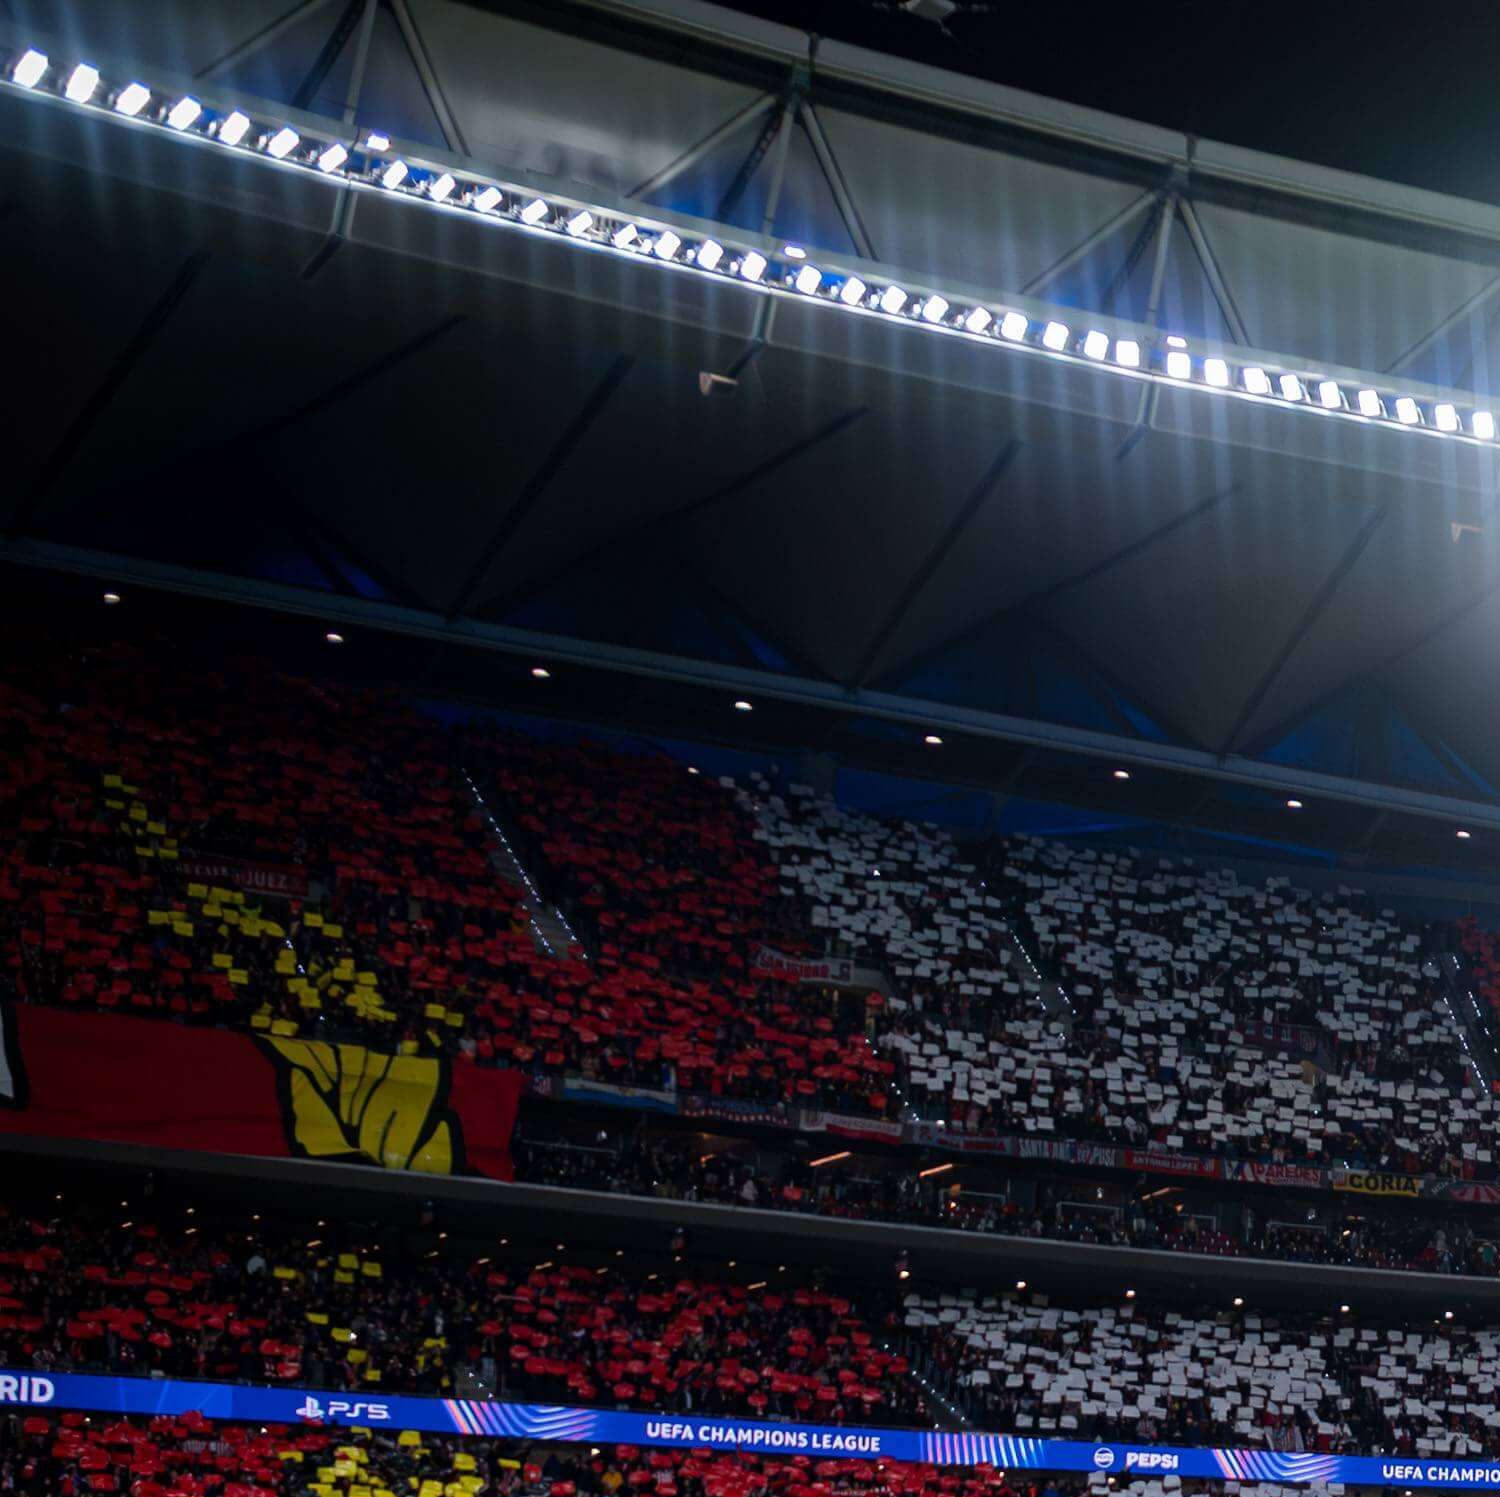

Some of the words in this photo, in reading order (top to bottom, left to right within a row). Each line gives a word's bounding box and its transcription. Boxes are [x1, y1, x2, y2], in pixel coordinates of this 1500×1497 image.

[1349, 1173, 1418, 1195] CORIA
[328, 1401, 390, 1420] PS5
[646, 1421, 694, 1440] UEFA
[698, 1426, 808, 1448] CHAMPIONS
[812, 1432, 881, 1452] LEAGUE
[1126, 1452, 1179, 1469] PEPSI
[1382, 1465, 1423, 1480] UEFA
